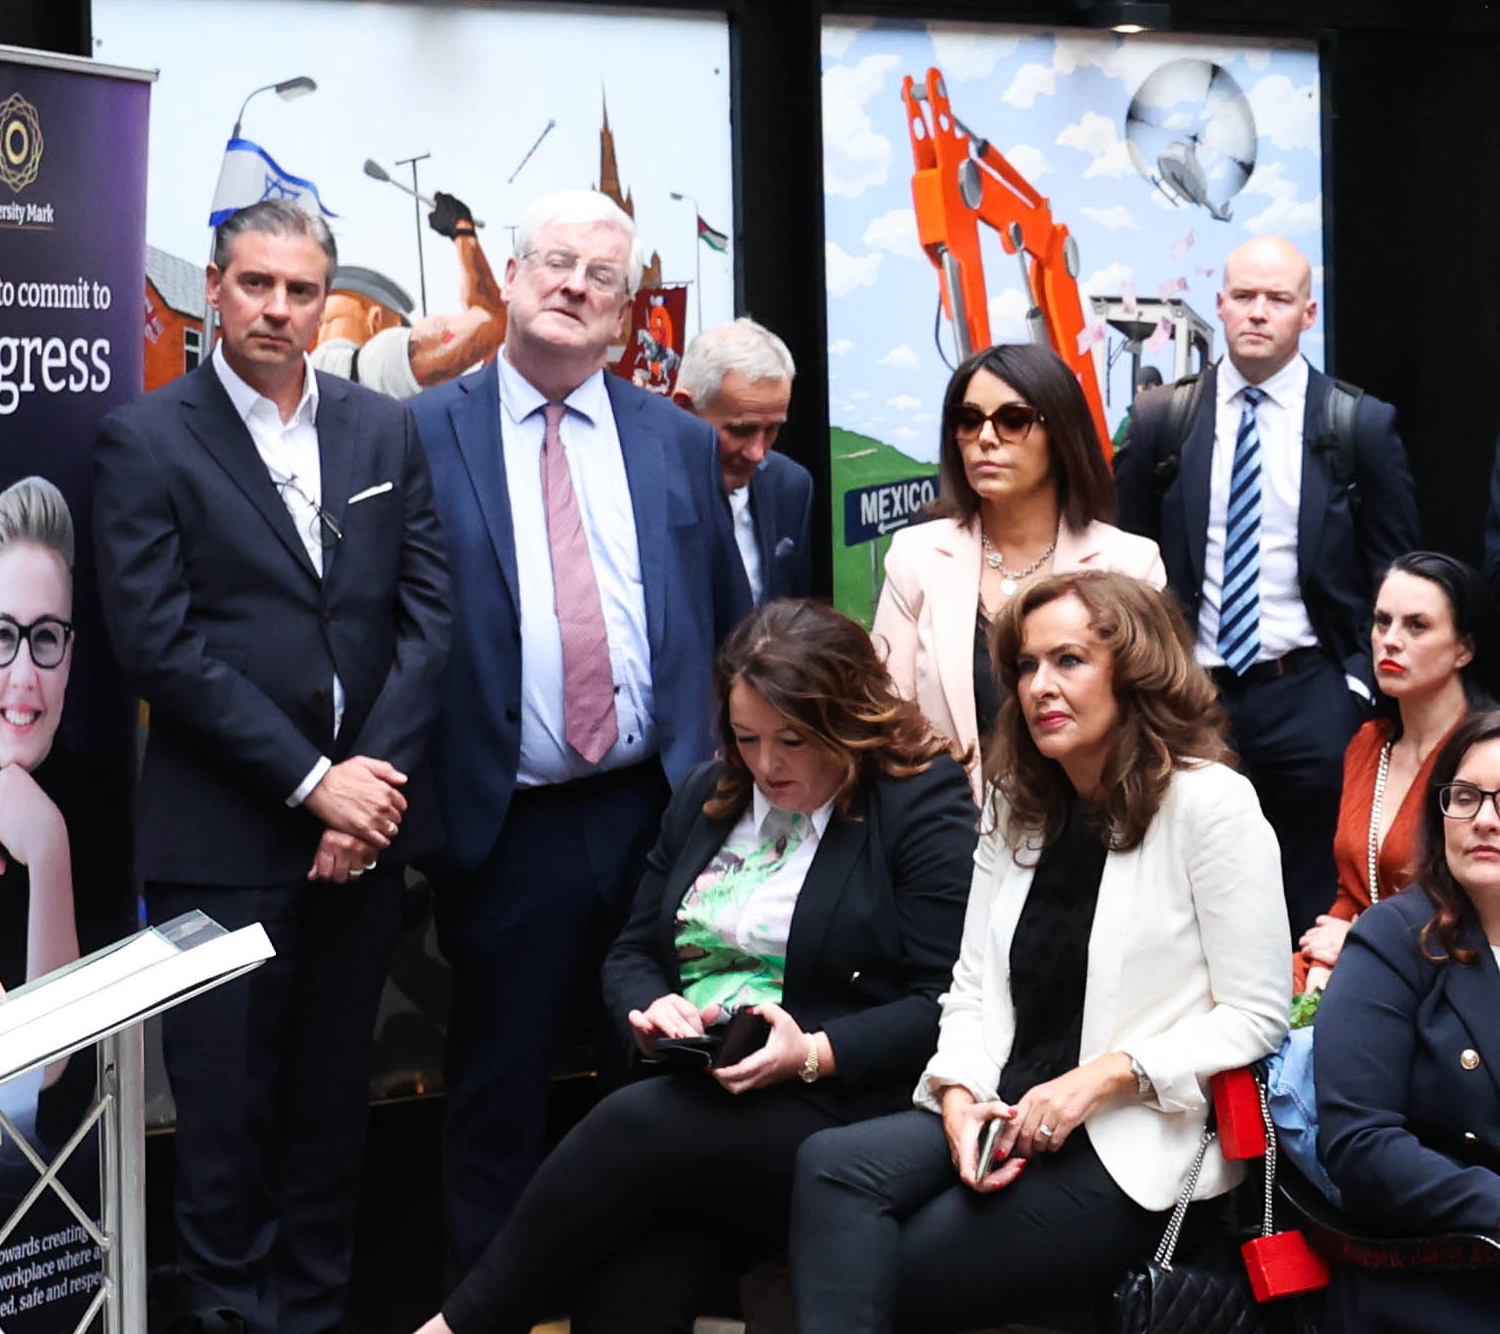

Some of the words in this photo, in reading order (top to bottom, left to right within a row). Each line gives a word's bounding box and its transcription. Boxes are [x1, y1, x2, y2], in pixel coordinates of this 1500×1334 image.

[27, 203, 54, 223] Mark
[17, 276, 91, 309] commit
[92, 281, 111, 310] to
[861, 480, 935, 526] MEXICO
[41, 1225, 89, 1251] creating
[56, 1250, 92, 1272] where
[19, 1291, 45, 1312] safe
[46, 1276, 68, 1302] and
